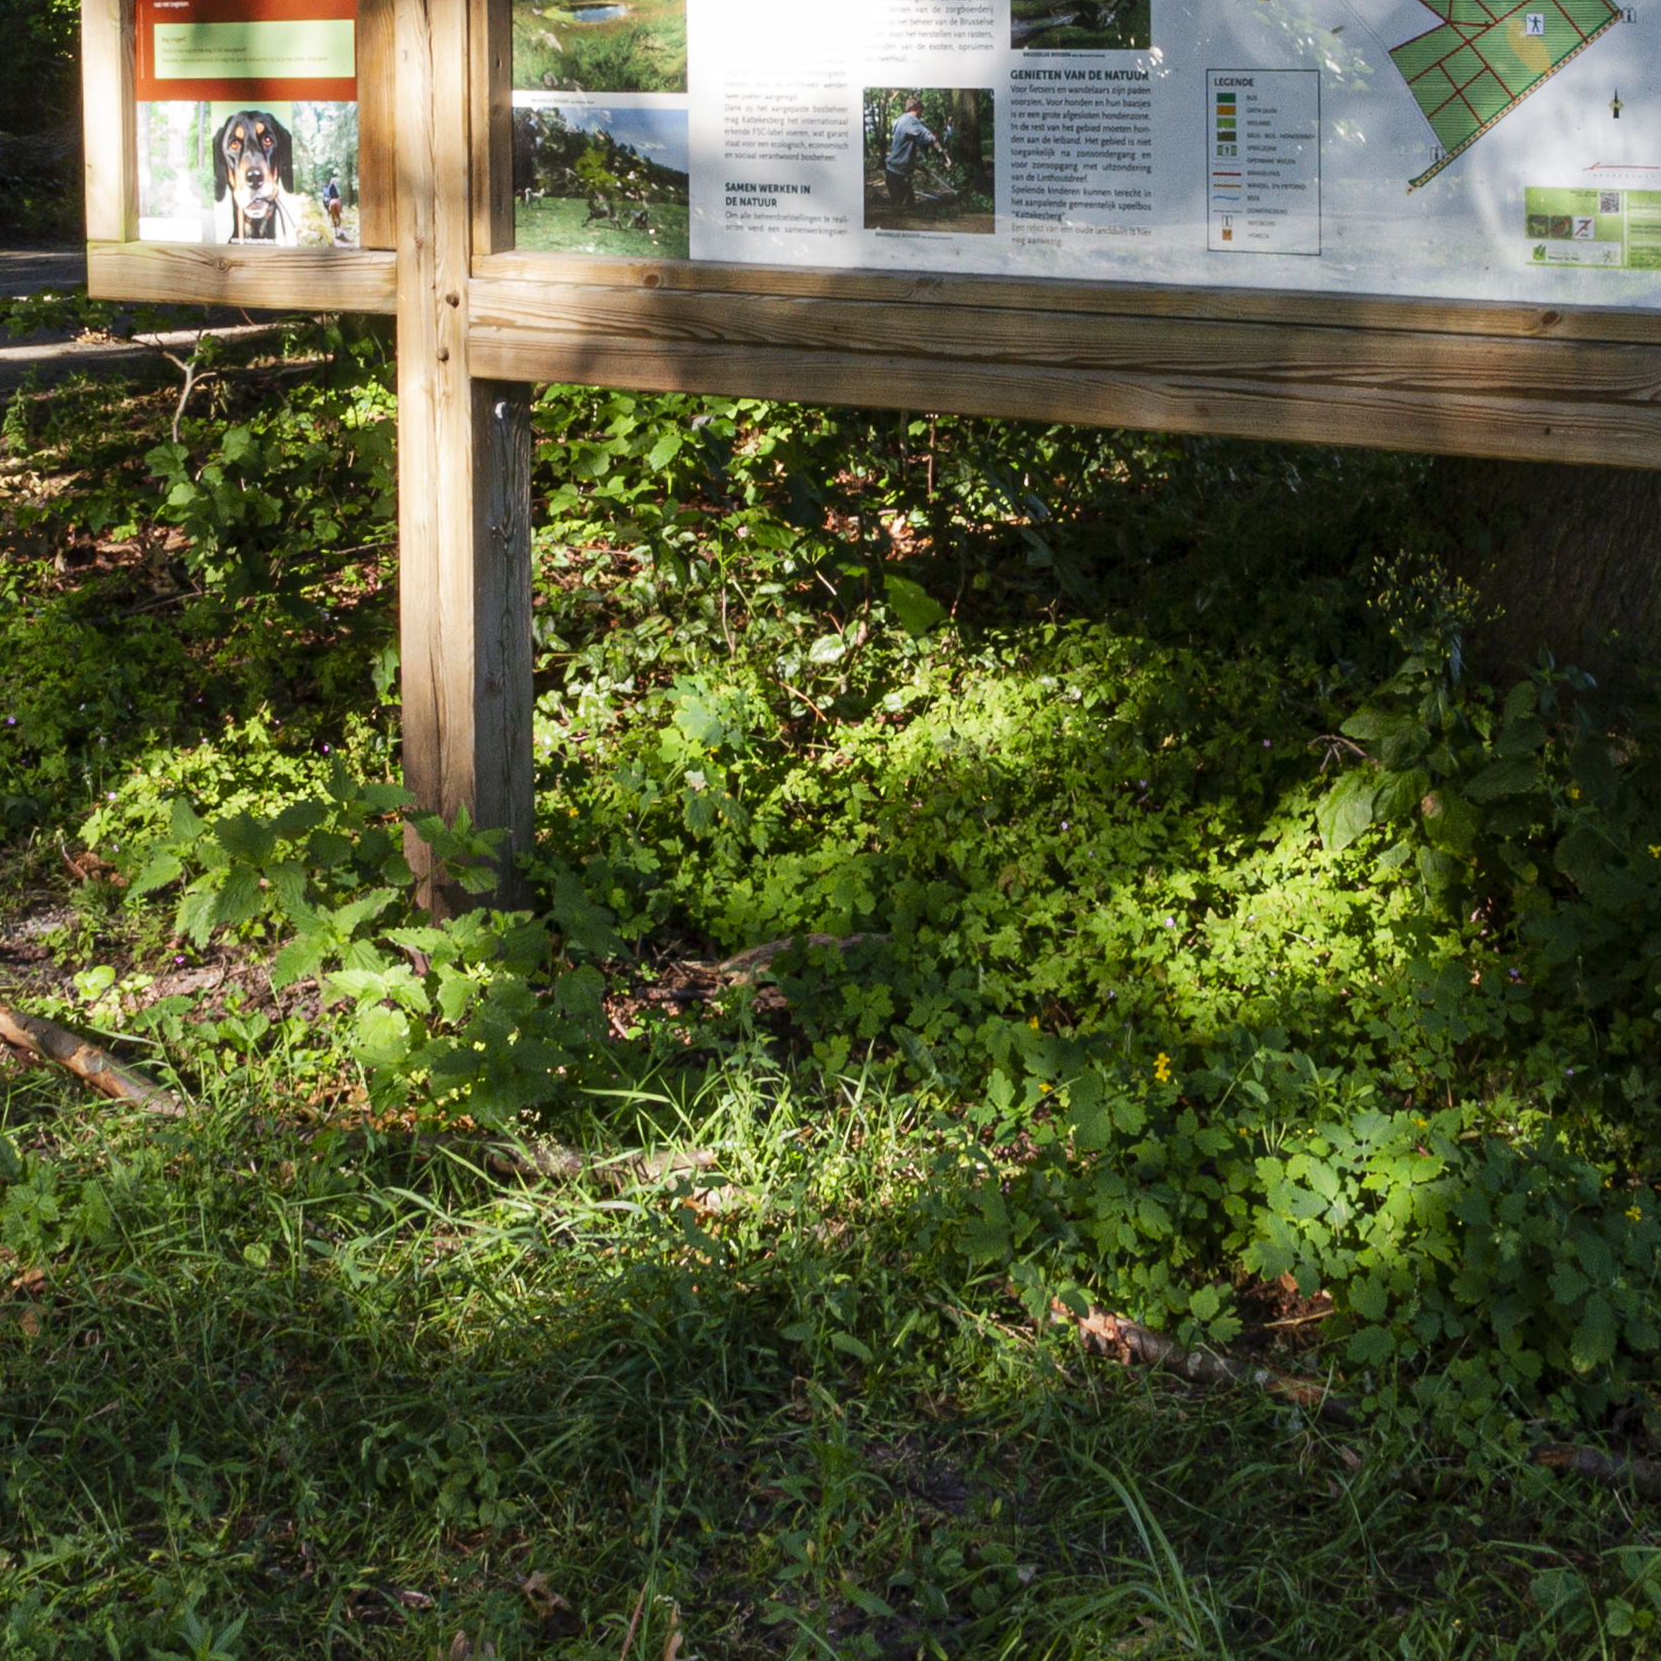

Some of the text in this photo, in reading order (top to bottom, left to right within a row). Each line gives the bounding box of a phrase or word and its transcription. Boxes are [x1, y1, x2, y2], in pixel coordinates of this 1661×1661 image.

[1009, 69, 1150, 82] GENIETEN VAN DE NATUUR
[1214, 77, 1254, 88] LEGENDE
[724, 182, 811, 195] SAMEN WERKEN IN
[724, 196, 778, 208] DE NATUUR
